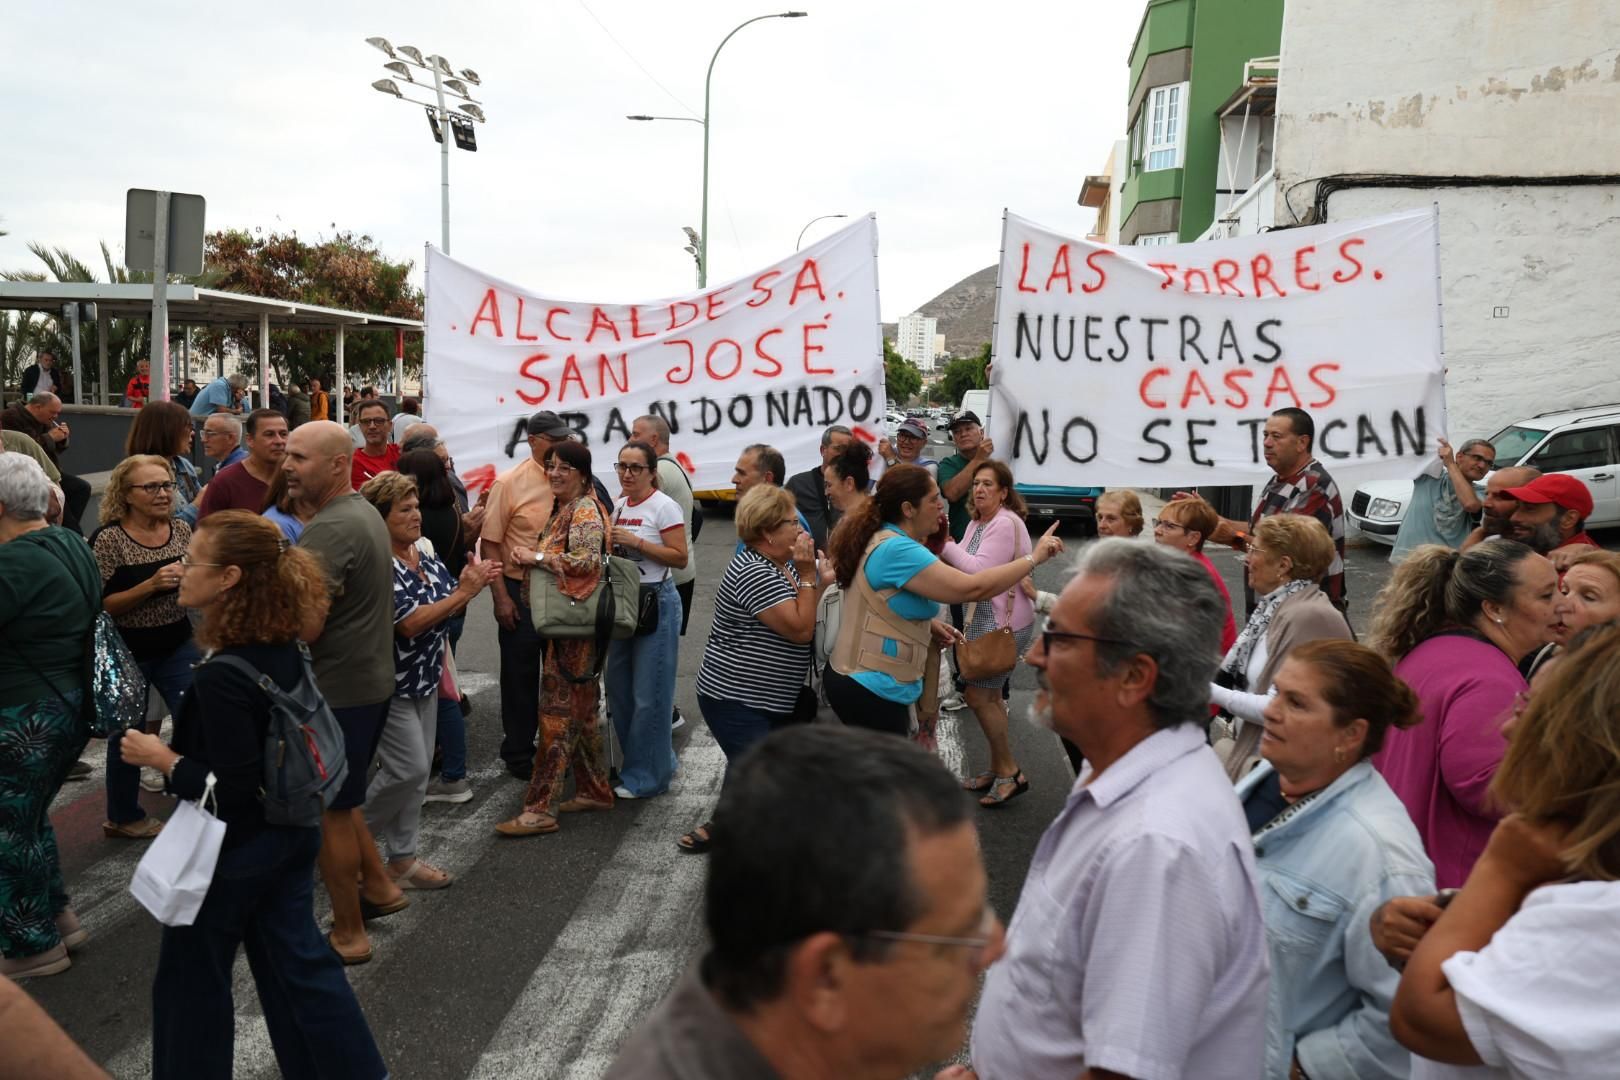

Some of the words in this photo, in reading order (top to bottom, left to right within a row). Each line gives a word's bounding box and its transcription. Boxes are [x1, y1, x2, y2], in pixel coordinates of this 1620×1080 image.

[1017, 242, 1115, 294] LAS
[1016, 312, 1284, 364] NUESTRAS
[1139, 364, 1341, 409] CASAS
[1013, 409, 1098, 465] NO
[1138, 419, 1217, 467] SE
[1237, 406, 1427, 463] TCAN
